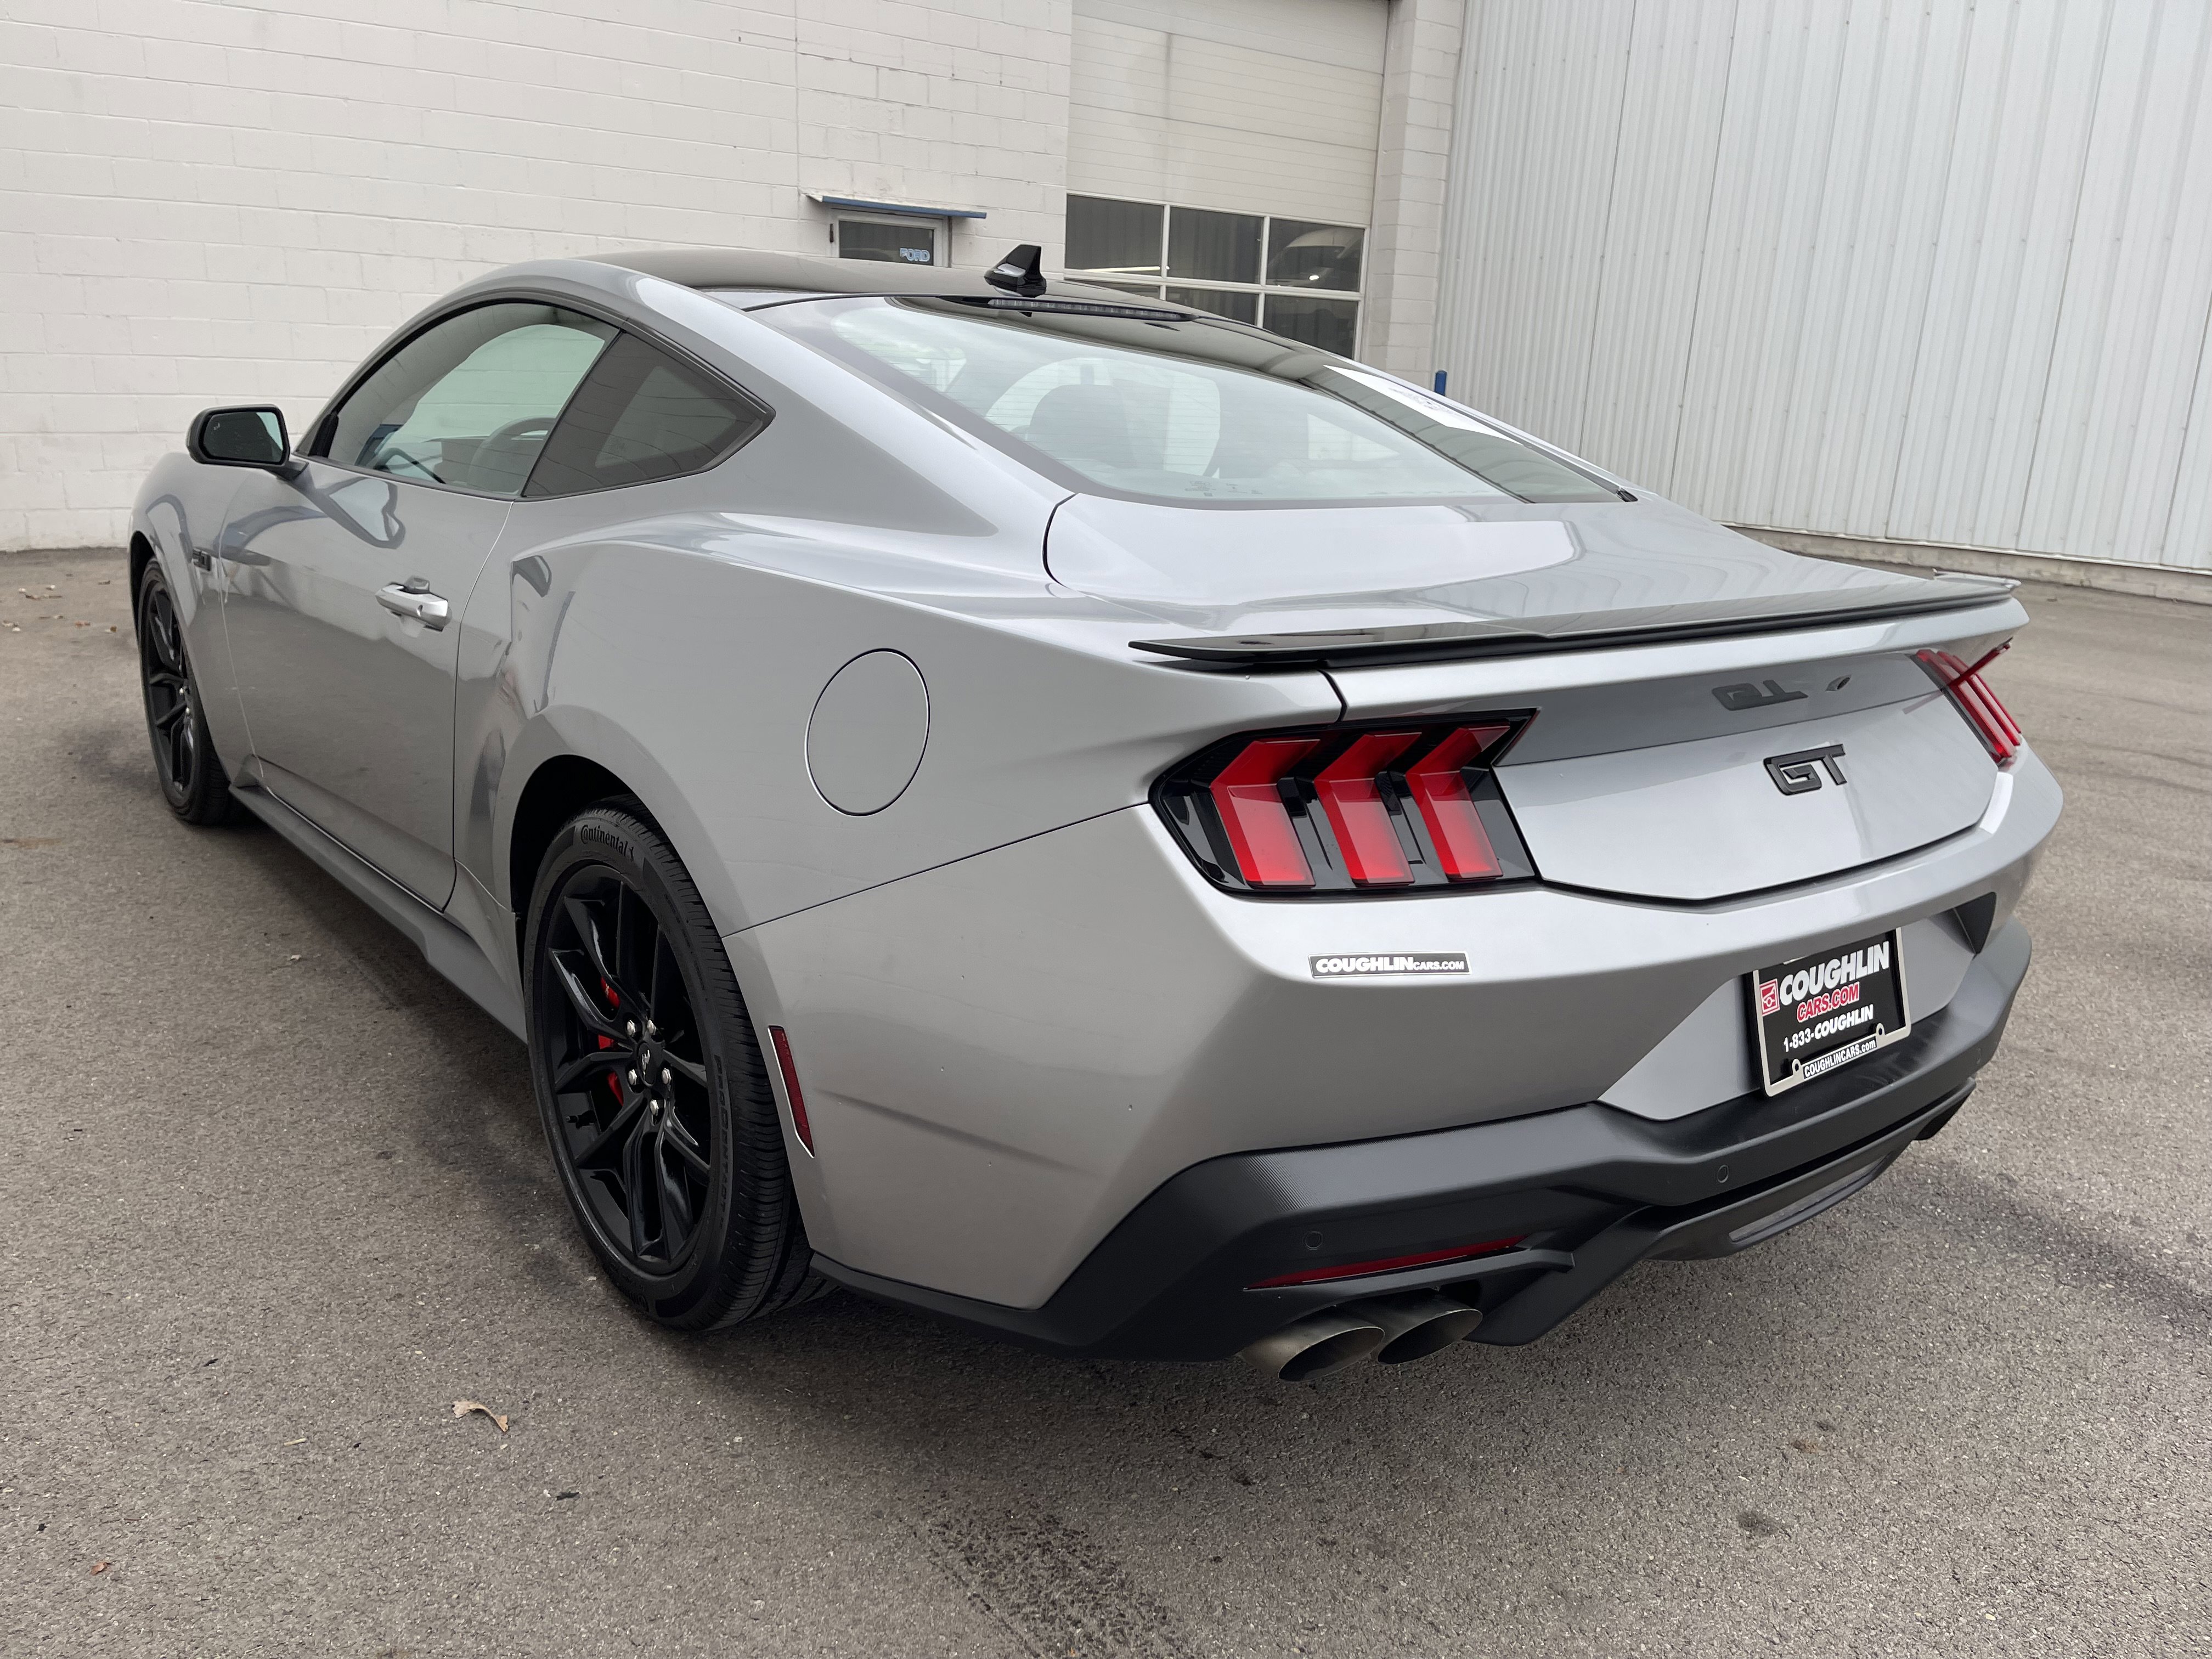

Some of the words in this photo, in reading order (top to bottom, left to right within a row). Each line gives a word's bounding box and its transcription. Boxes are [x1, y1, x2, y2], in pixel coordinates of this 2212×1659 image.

[900, 247, 930, 262] FORD
[1763, 743, 1847, 796] GT
[580, 825, 628, 857] Continental
[1779, 941, 1889, 1006] COUGHLIN
[1796, 981, 1860, 1023] CARS.COM
[1784, 1004, 1874, 1052] 1-833-COUGHLIN
[1804, 1040, 1876, 1078] COUGHLINCARS.com
